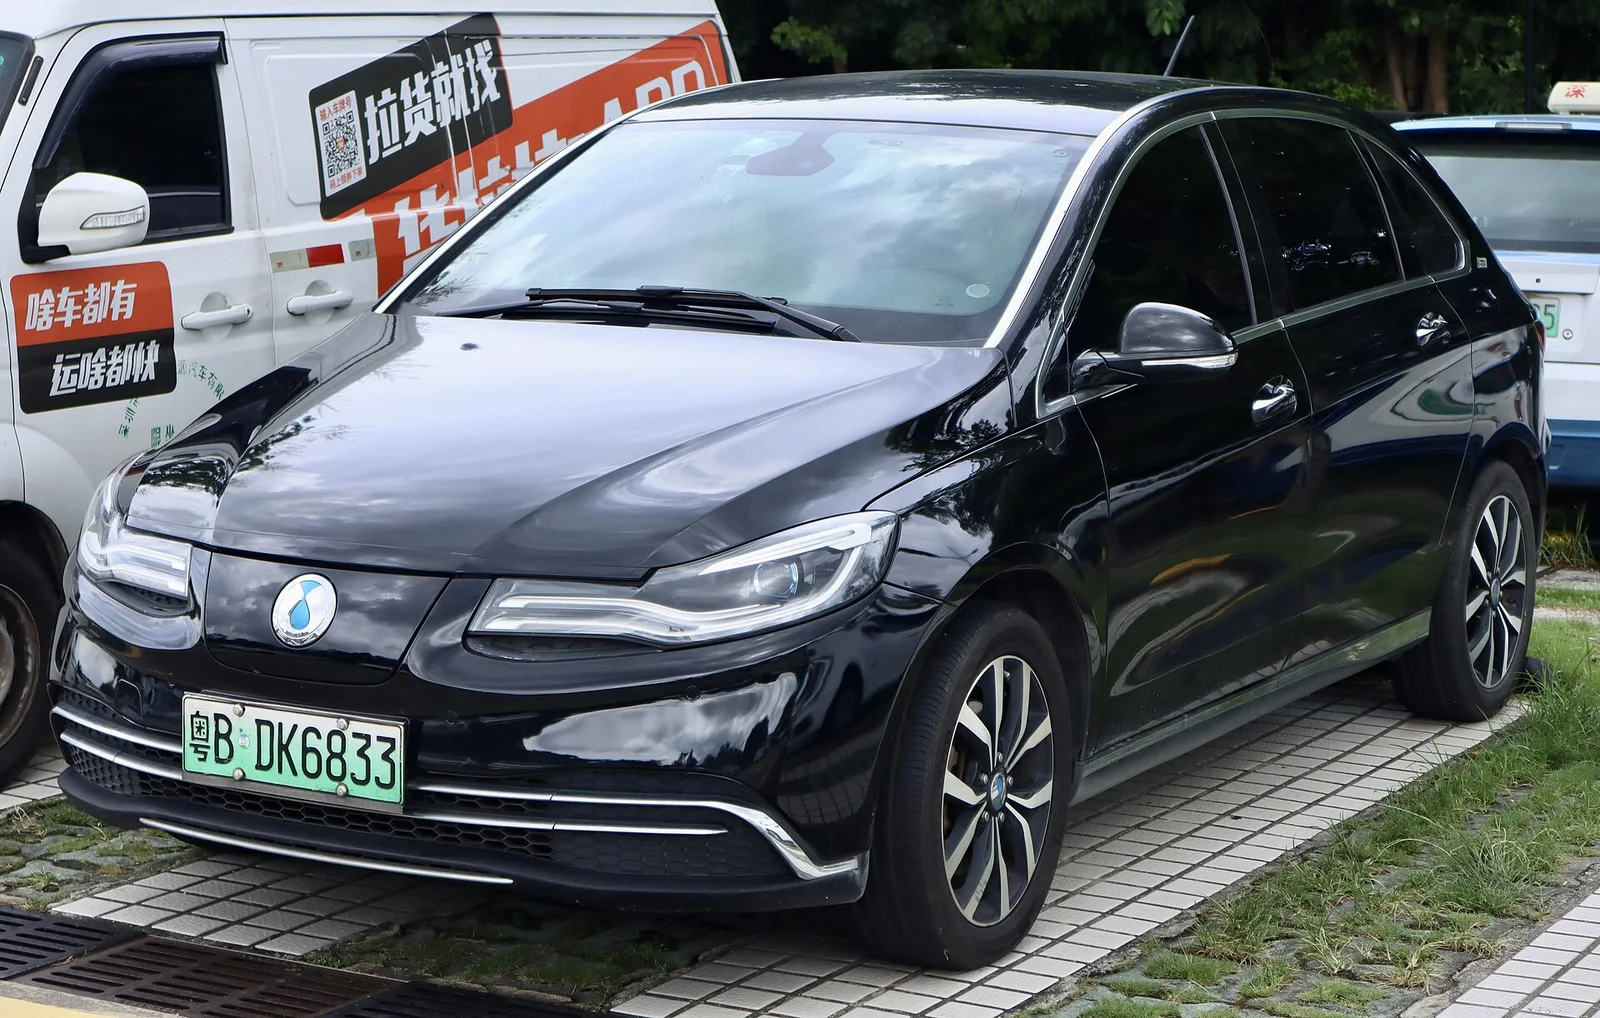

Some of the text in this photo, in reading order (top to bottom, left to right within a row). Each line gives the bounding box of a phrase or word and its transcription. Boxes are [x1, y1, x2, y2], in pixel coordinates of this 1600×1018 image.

[320, 96, 352, 121] 输入车牌号
[364, 39, 501, 165] 拉货就找
[1565, 85, 1588, 98] 深
[25, 280, 137, 332] 啥车都有
[49, 340, 159, 397] 运啥都快
[255, 718, 396, 789] DK6833
